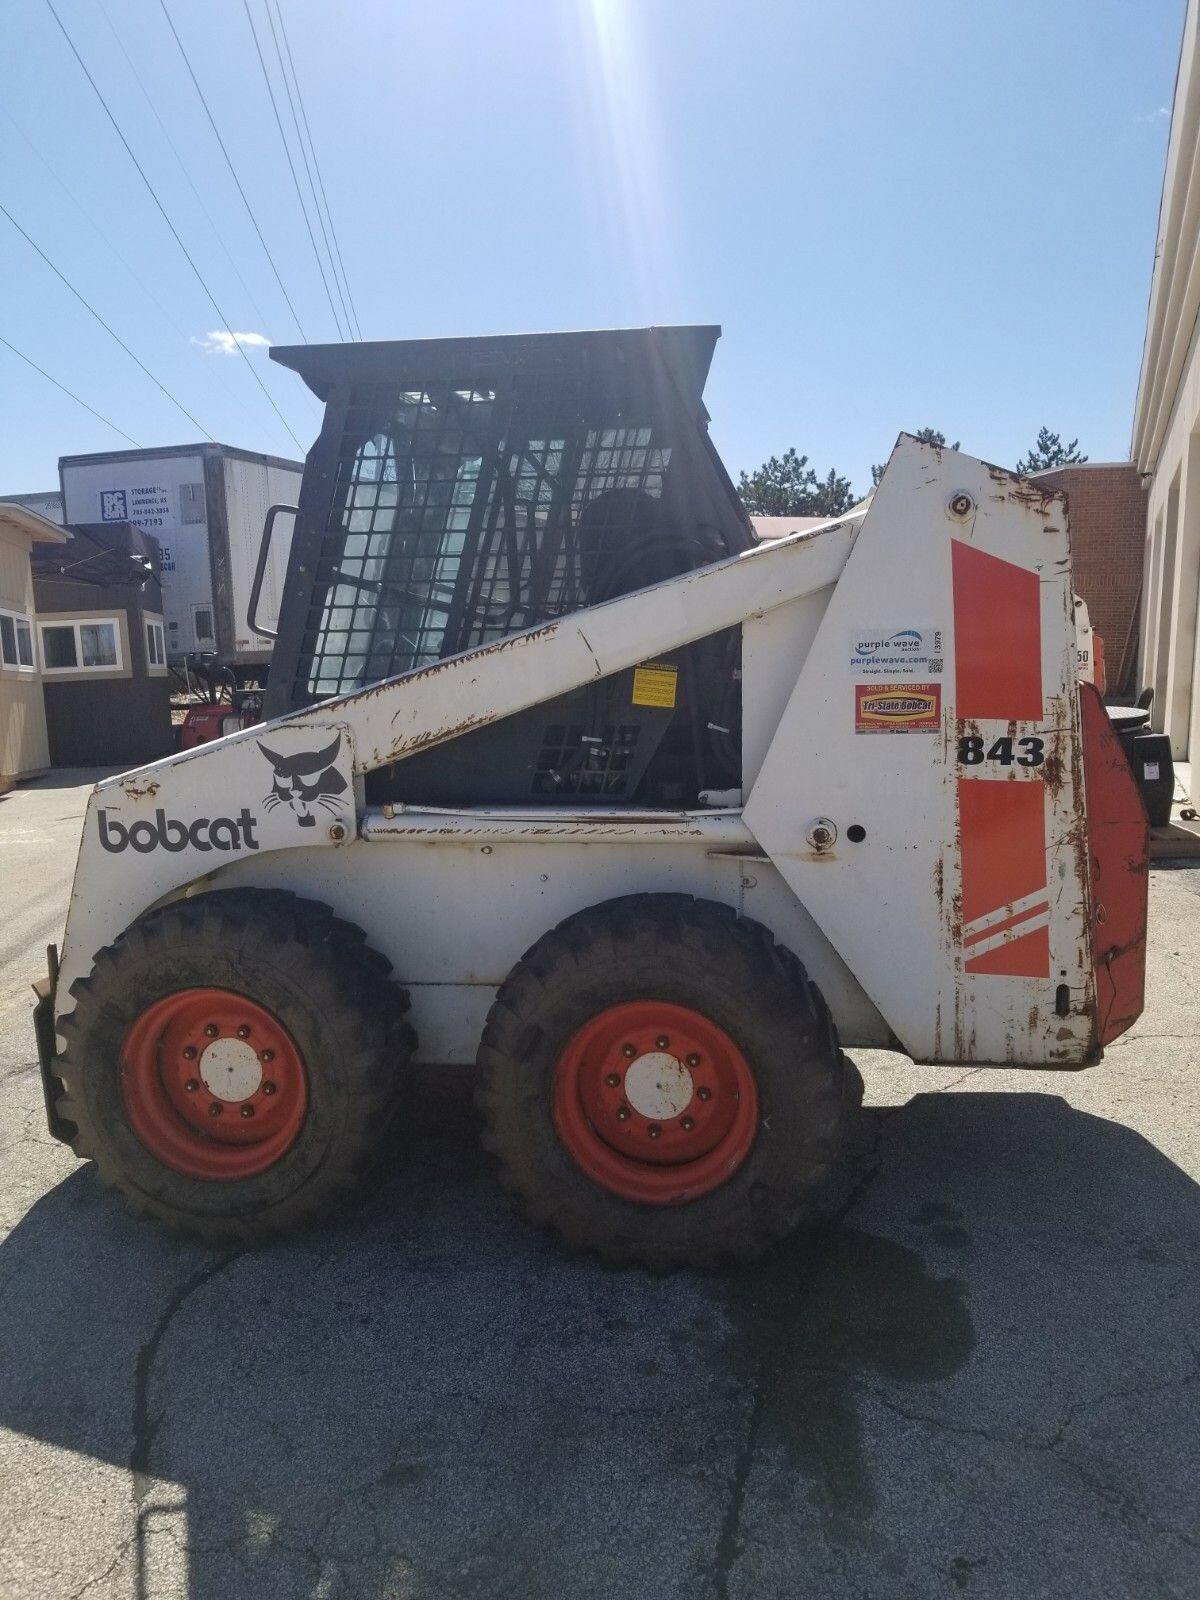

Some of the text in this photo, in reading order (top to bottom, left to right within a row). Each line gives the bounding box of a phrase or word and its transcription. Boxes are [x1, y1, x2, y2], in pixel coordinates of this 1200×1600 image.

[131, 486, 156, 495] STORAGE
[858, 640, 890, 649] purple
[850, 656, 927, 665] purplewave.com
[863, 700, 932, 710] Tri-State Bobcat
[957, 736, 1045, 767] 843
[97, 808, 260, 854] bobcat
